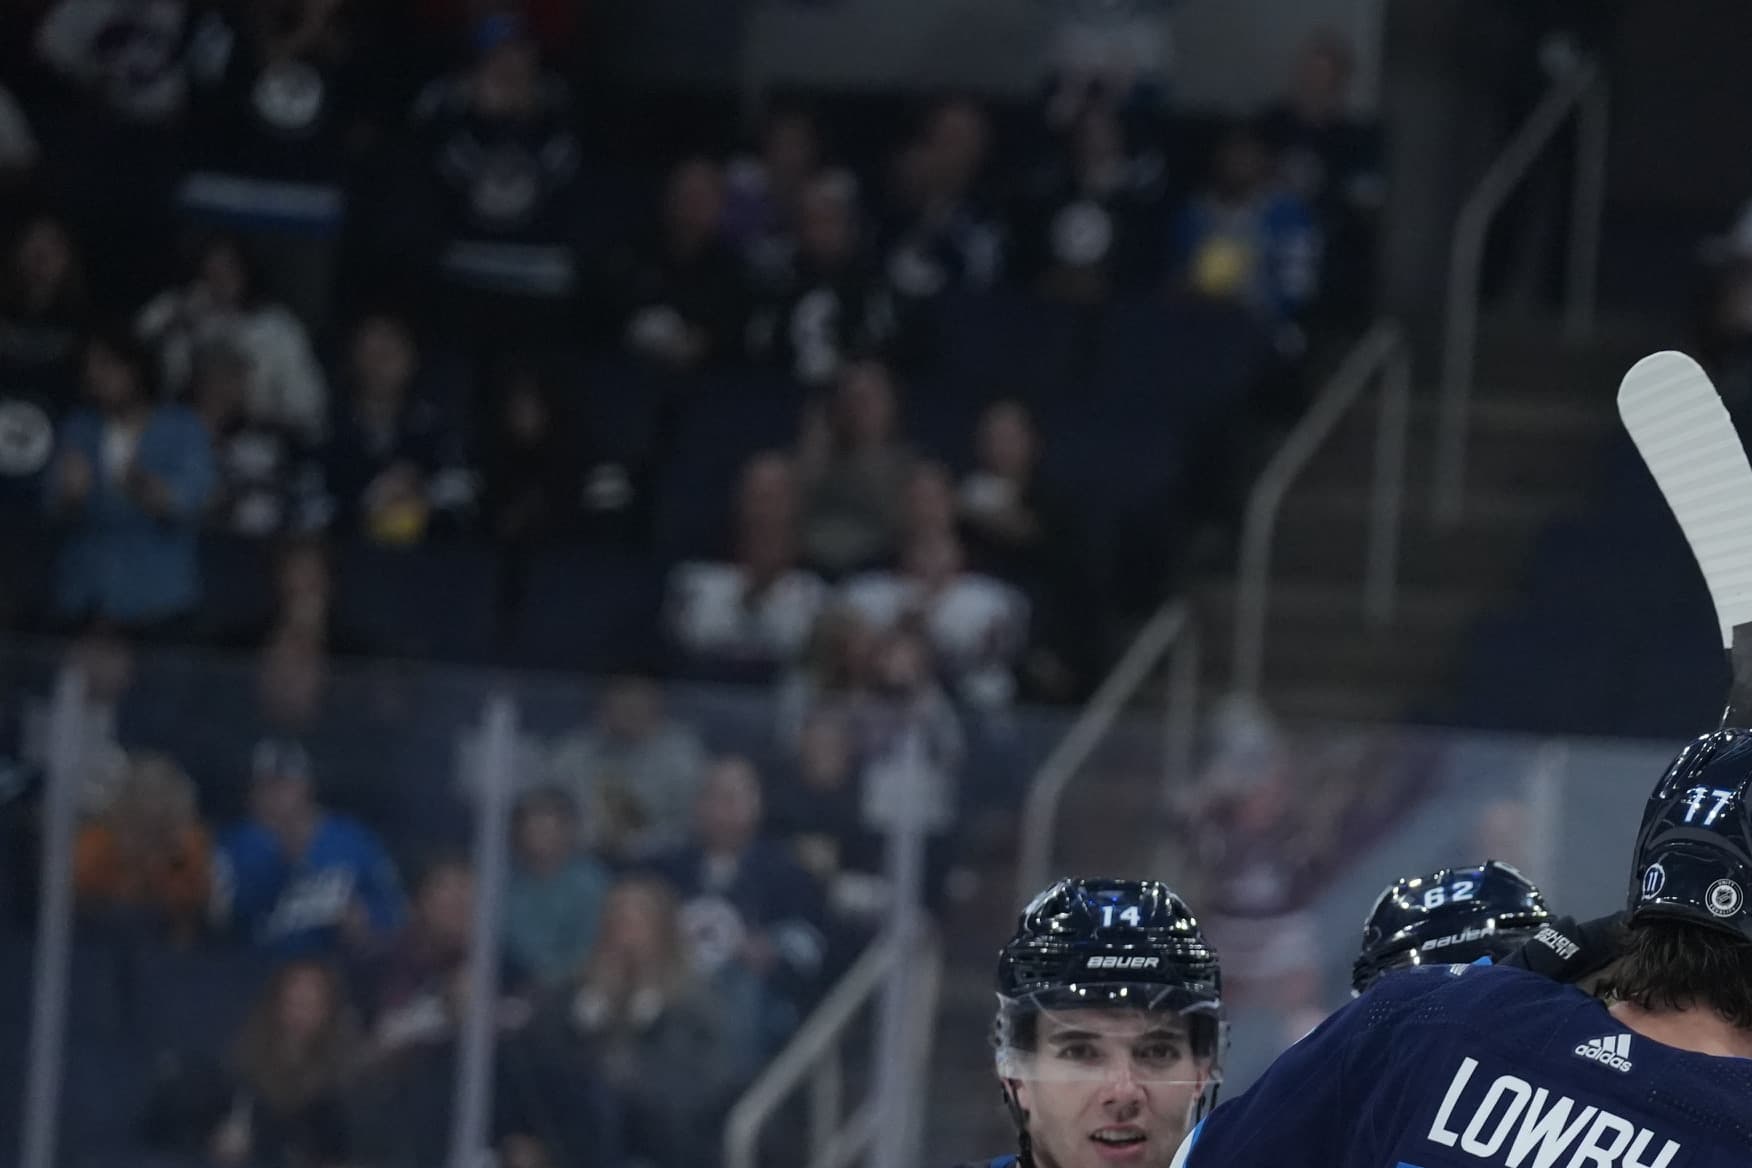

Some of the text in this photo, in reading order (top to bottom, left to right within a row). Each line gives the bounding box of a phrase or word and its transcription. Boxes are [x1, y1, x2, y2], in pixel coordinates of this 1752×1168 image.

[1683, 785, 1733, 825] 17
[1423, 881, 1474, 910] 62
[1101, 905, 1140, 927] 14
[1574, 1043, 1633, 1073] adidas
